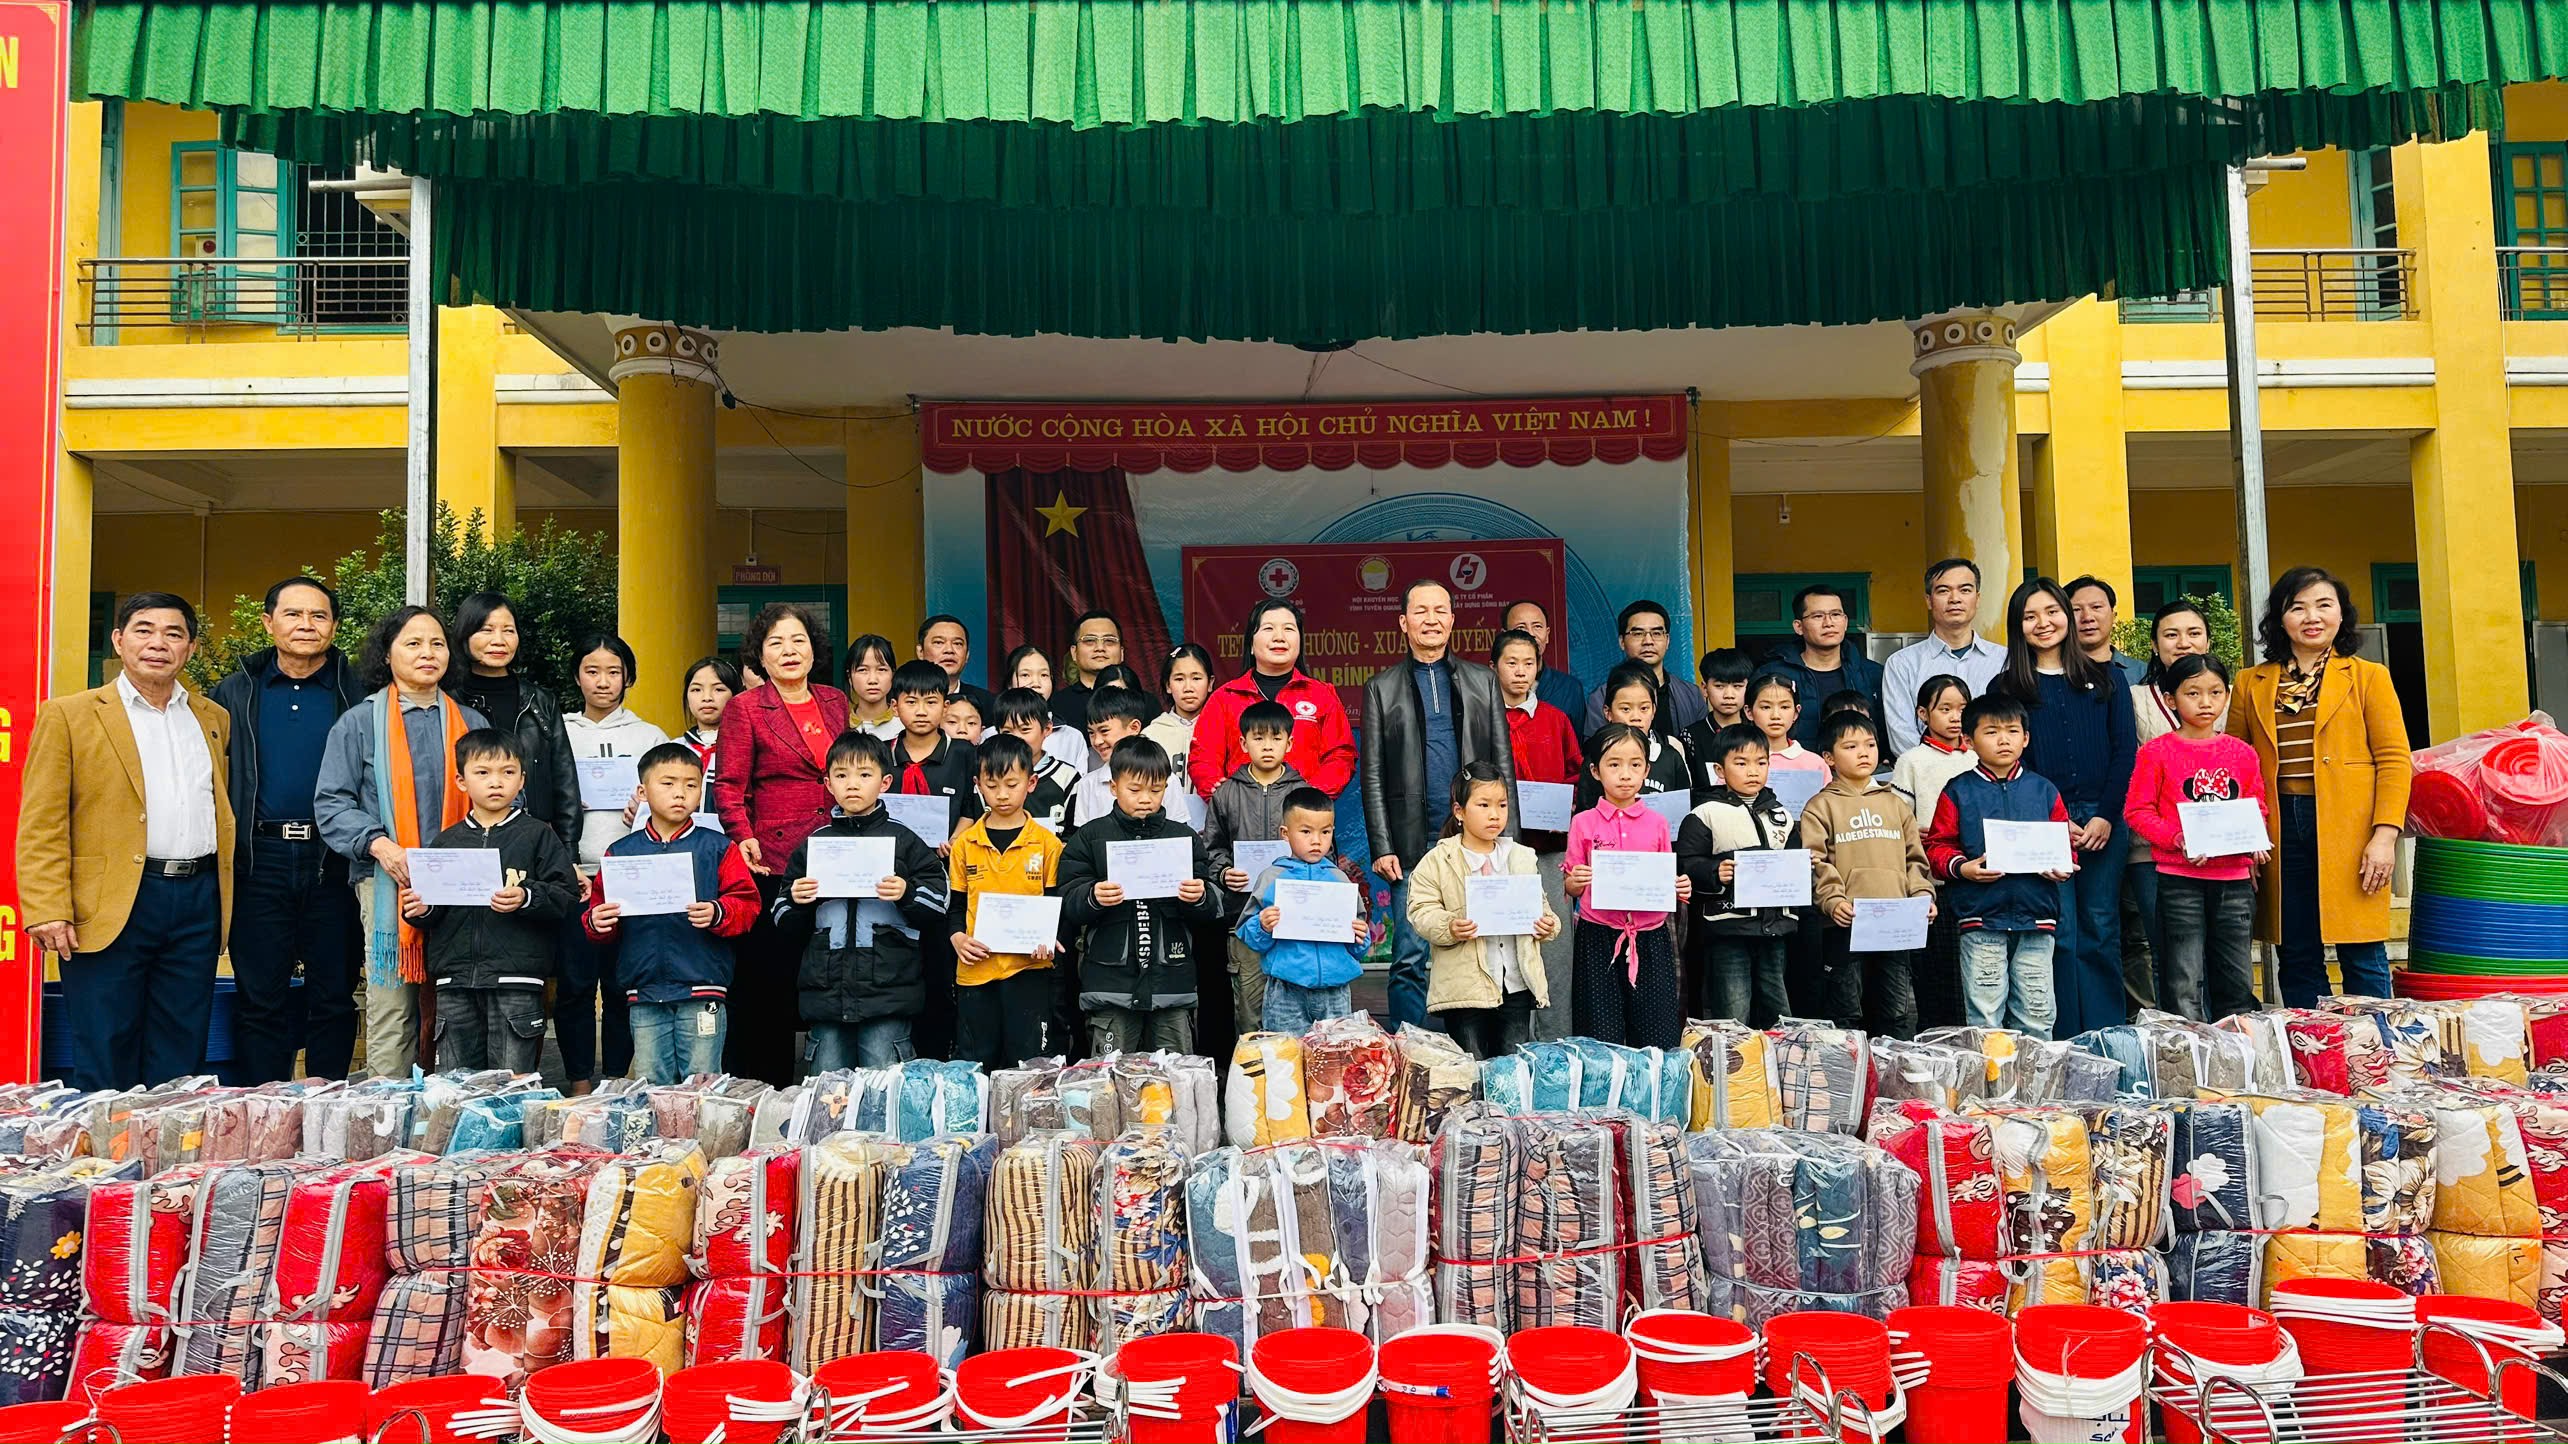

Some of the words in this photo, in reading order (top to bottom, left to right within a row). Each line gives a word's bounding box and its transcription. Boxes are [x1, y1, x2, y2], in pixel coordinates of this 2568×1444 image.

[952, 412, 1033, 438] NƯỚC
[1041, 412, 1124, 443] CỘNG
[1132, 412, 1196, 437] HÒA
[1204, 414, 1248, 437] XÃ
[1256, 411, 1310, 441] HỘI
[1318, 406, 1377, 434] CHỦ
[1387, 410, 1483, 434] NGHĨA
[1492, 407, 1561, 436] VIỆT
[1568, 409, 1638, 429] NAM
[1303, 627, 1360, 657] HƯƠNG
[1451, 615, 1497, 653] UYẾN
[1849, 807, 1883, 829] allo
